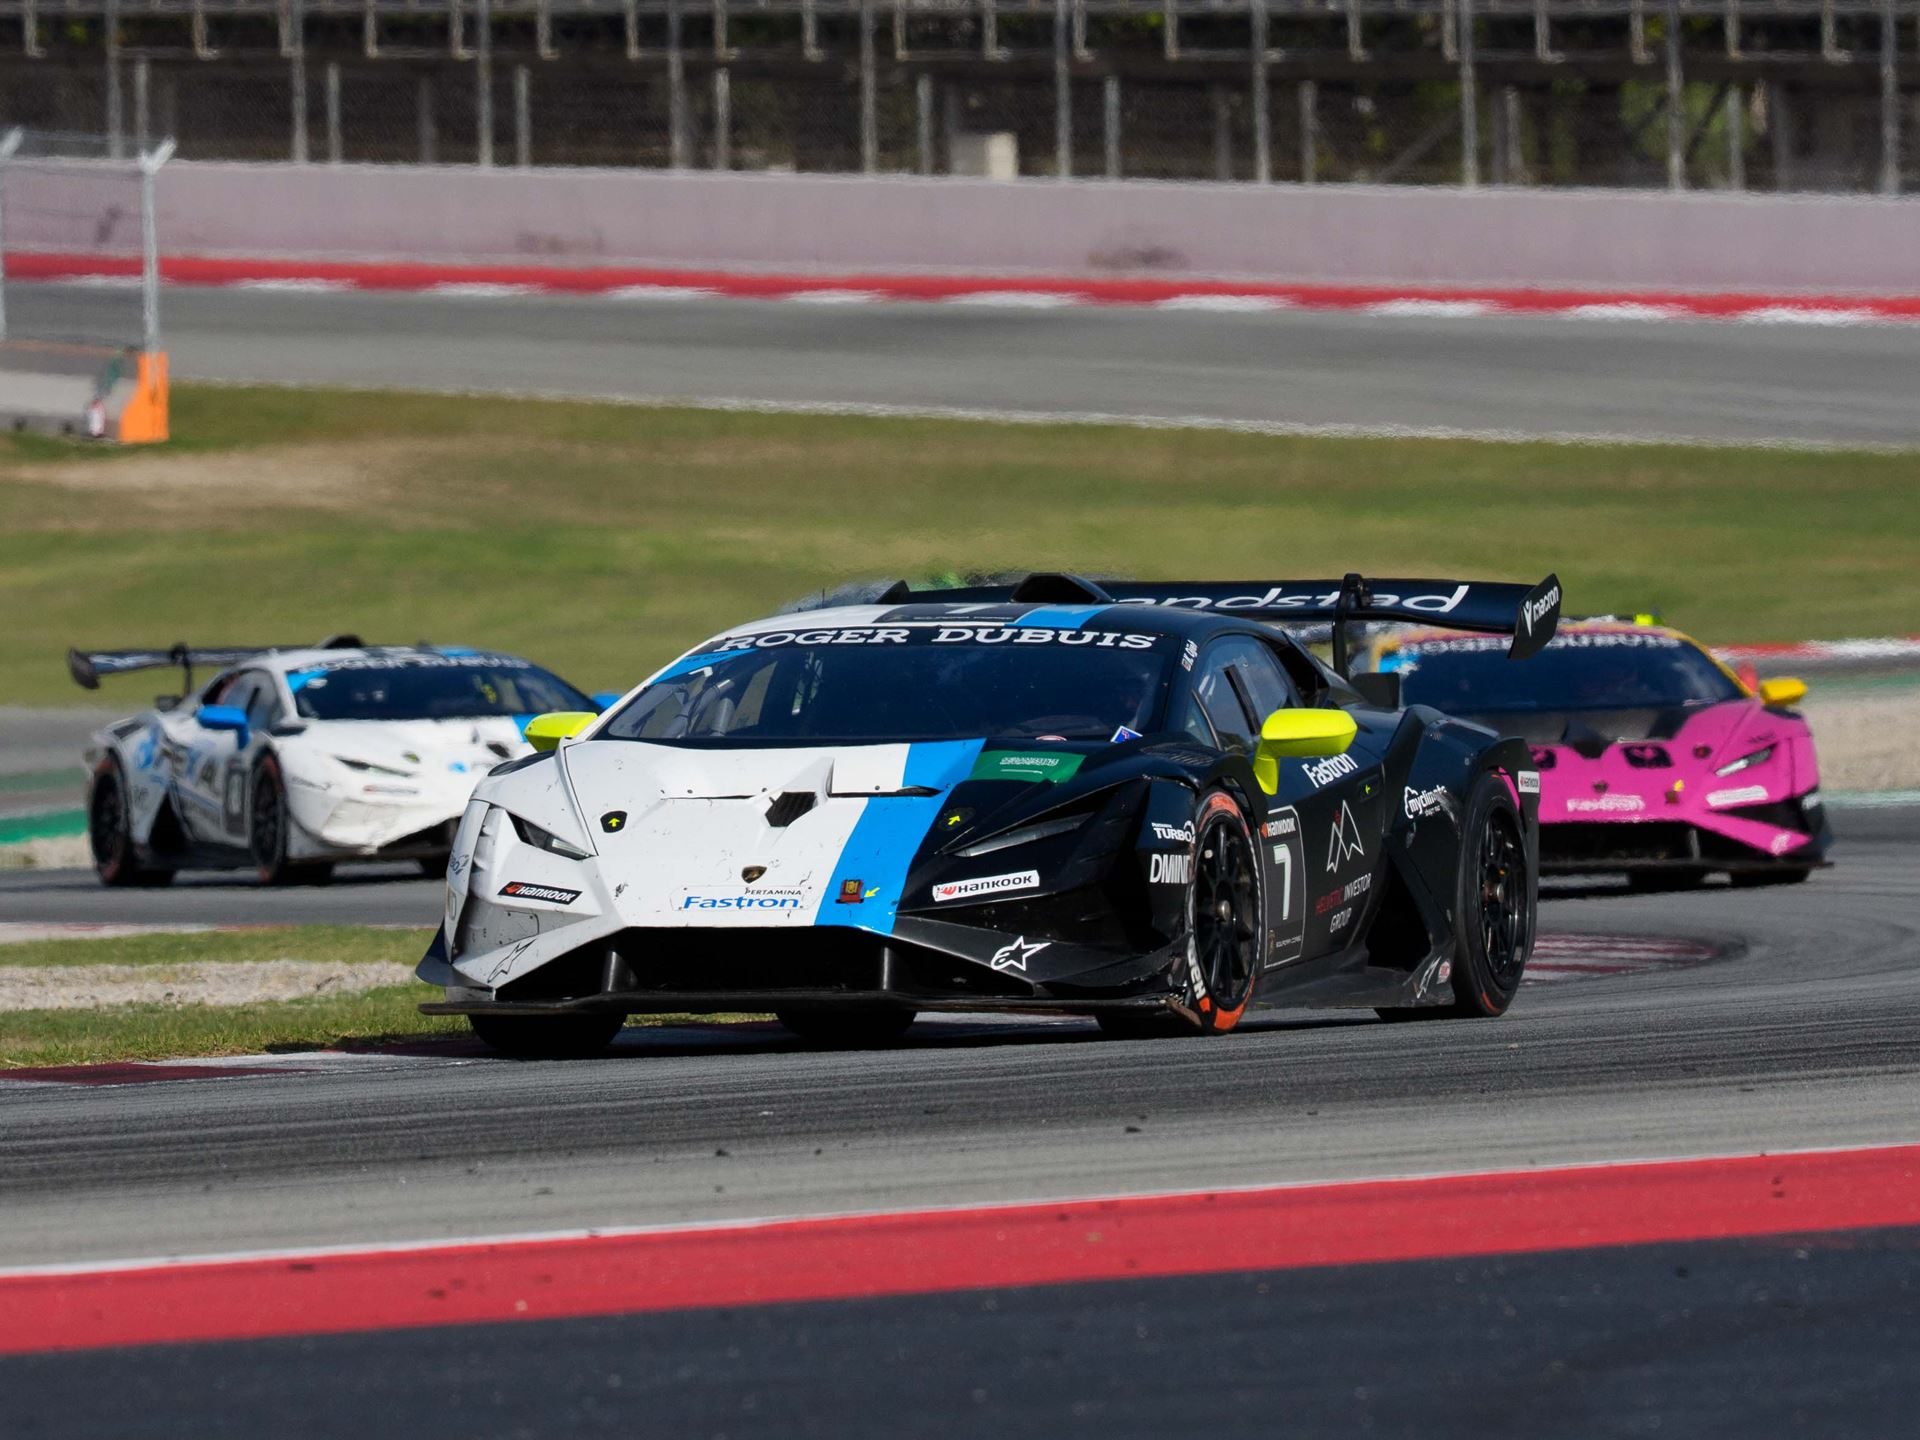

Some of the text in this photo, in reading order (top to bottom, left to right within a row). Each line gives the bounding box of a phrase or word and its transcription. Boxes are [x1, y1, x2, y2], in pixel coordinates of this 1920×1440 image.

[1533, 586, 1559, 622] macron
[712, 628, 1156, 652] ROGER DUBUIS
[1302, 752, 1358, 788] Fastron
[1153, 827, 1192, 842] TURBO
[745, 887, 802, 895] PERTAMINA
[1273, 843, 1292, 921] 7
[683, 896, 799, 909] Fastron
